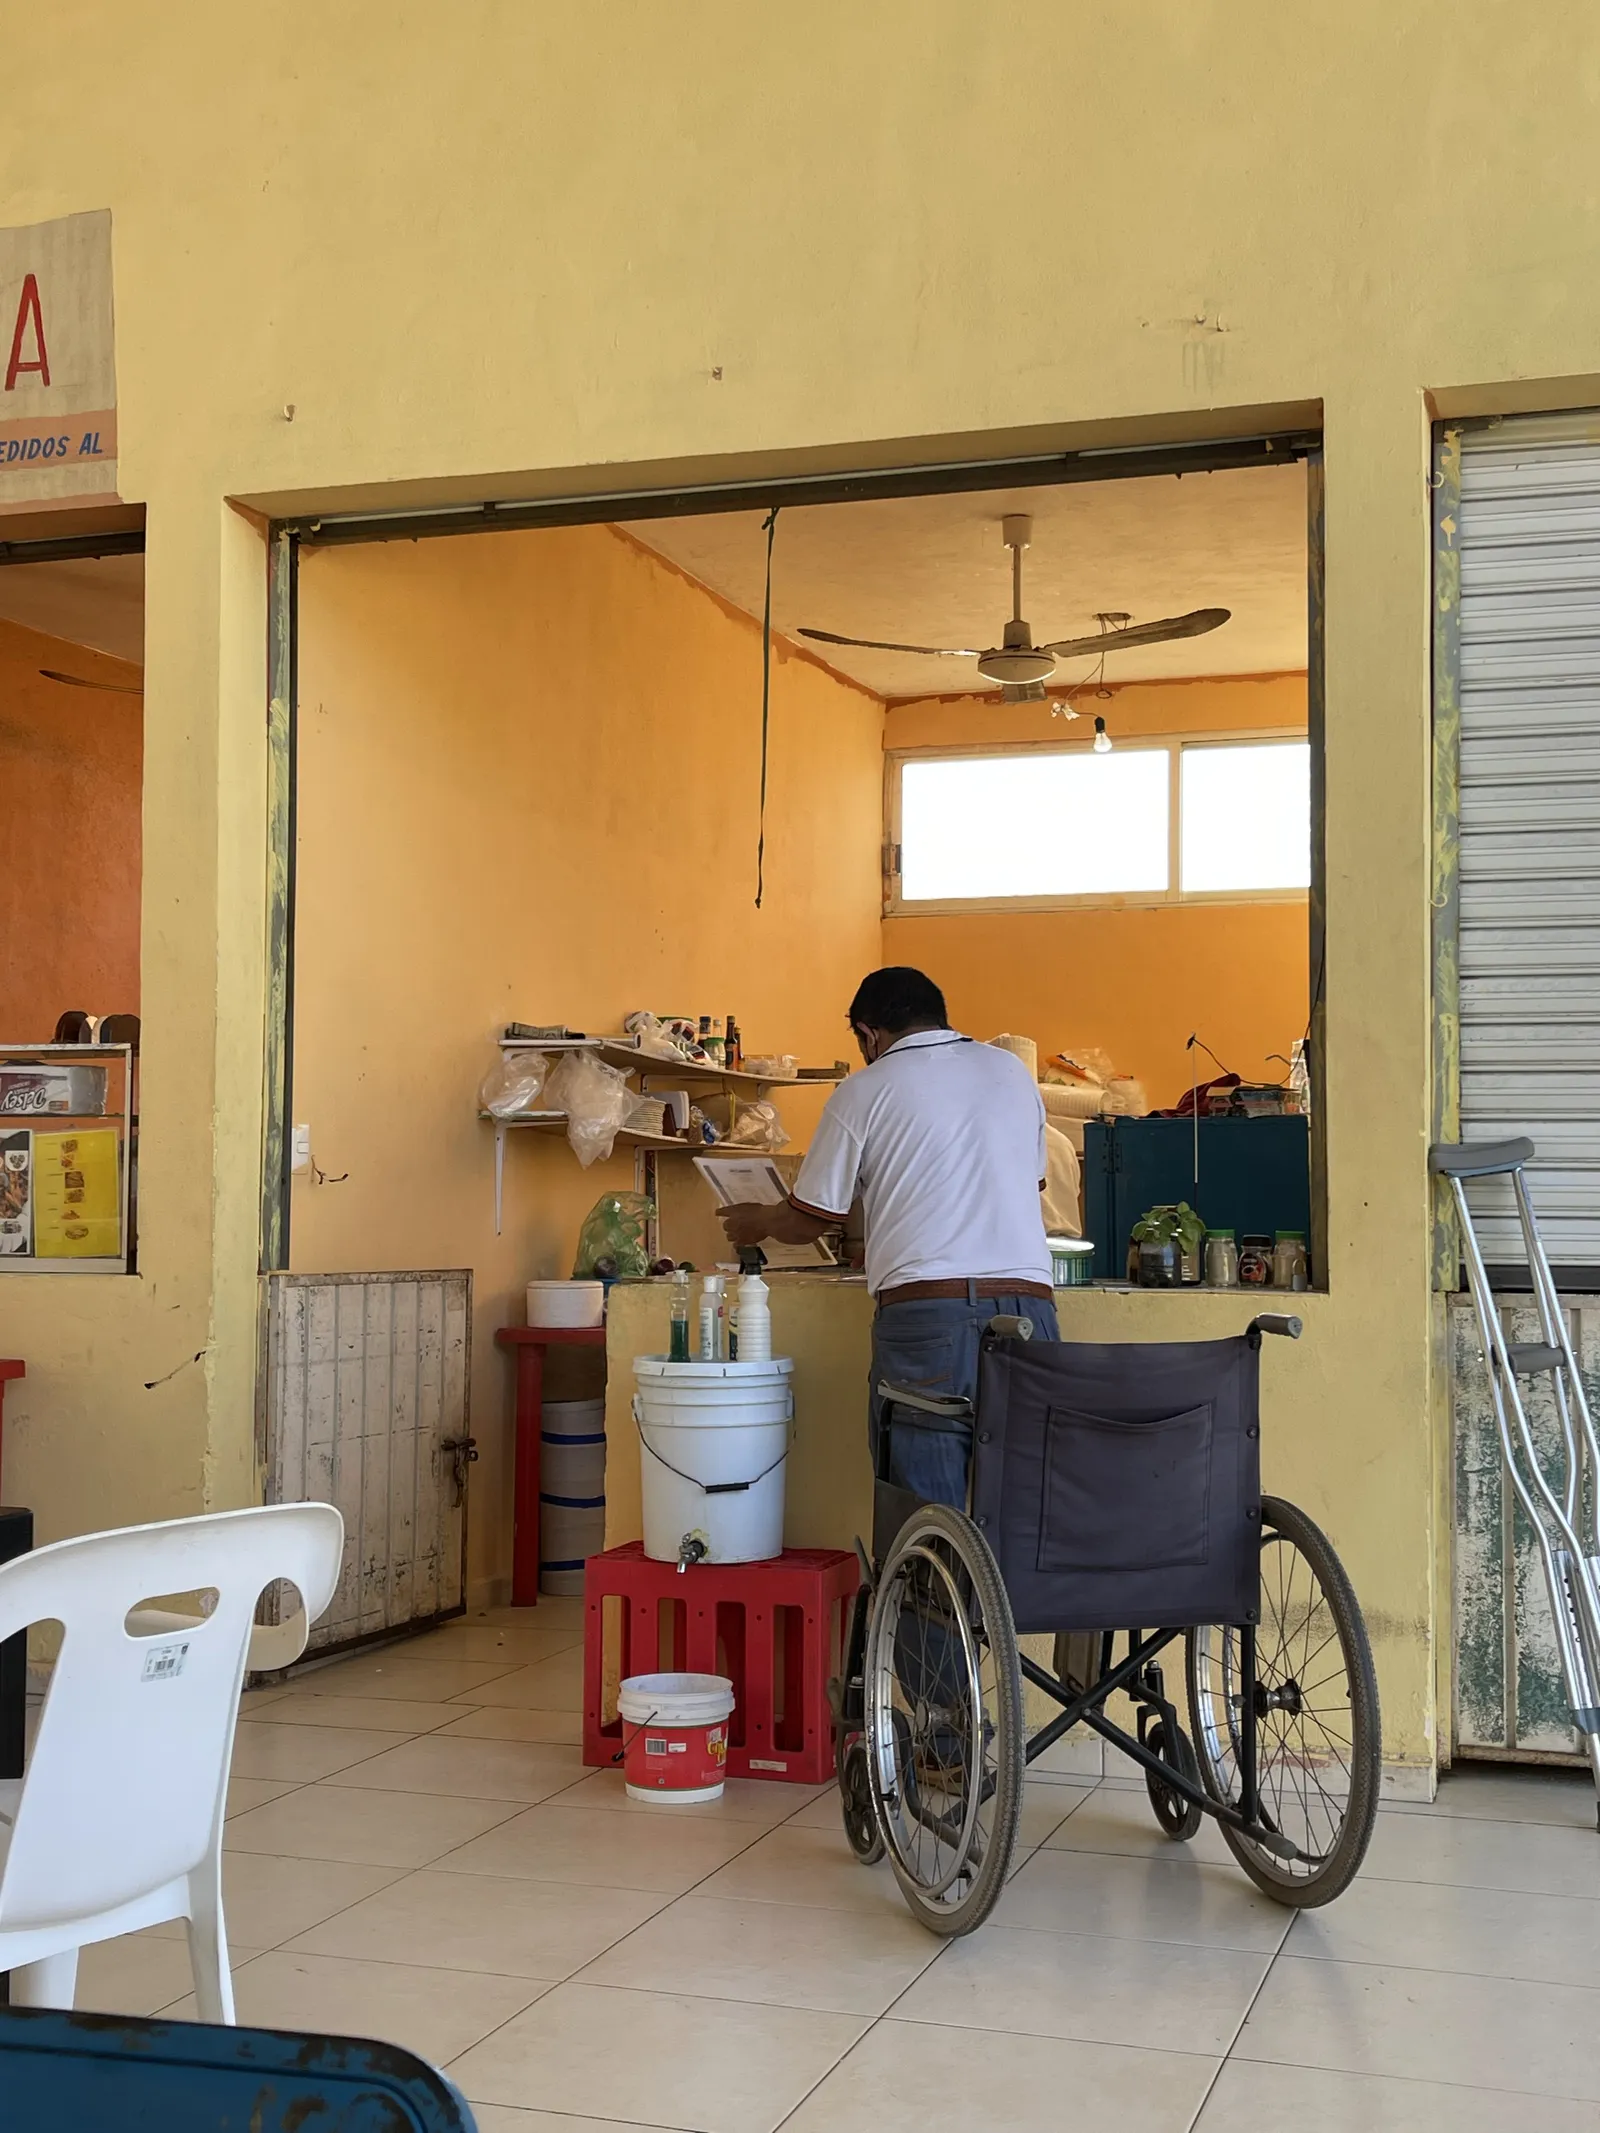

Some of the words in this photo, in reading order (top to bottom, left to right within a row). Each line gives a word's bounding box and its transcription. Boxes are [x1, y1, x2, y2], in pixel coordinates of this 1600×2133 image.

[5, 273, 51, 391] A
[79, 432, 103, 455] AL
[0, 1088, 46, 1111] Delsey
